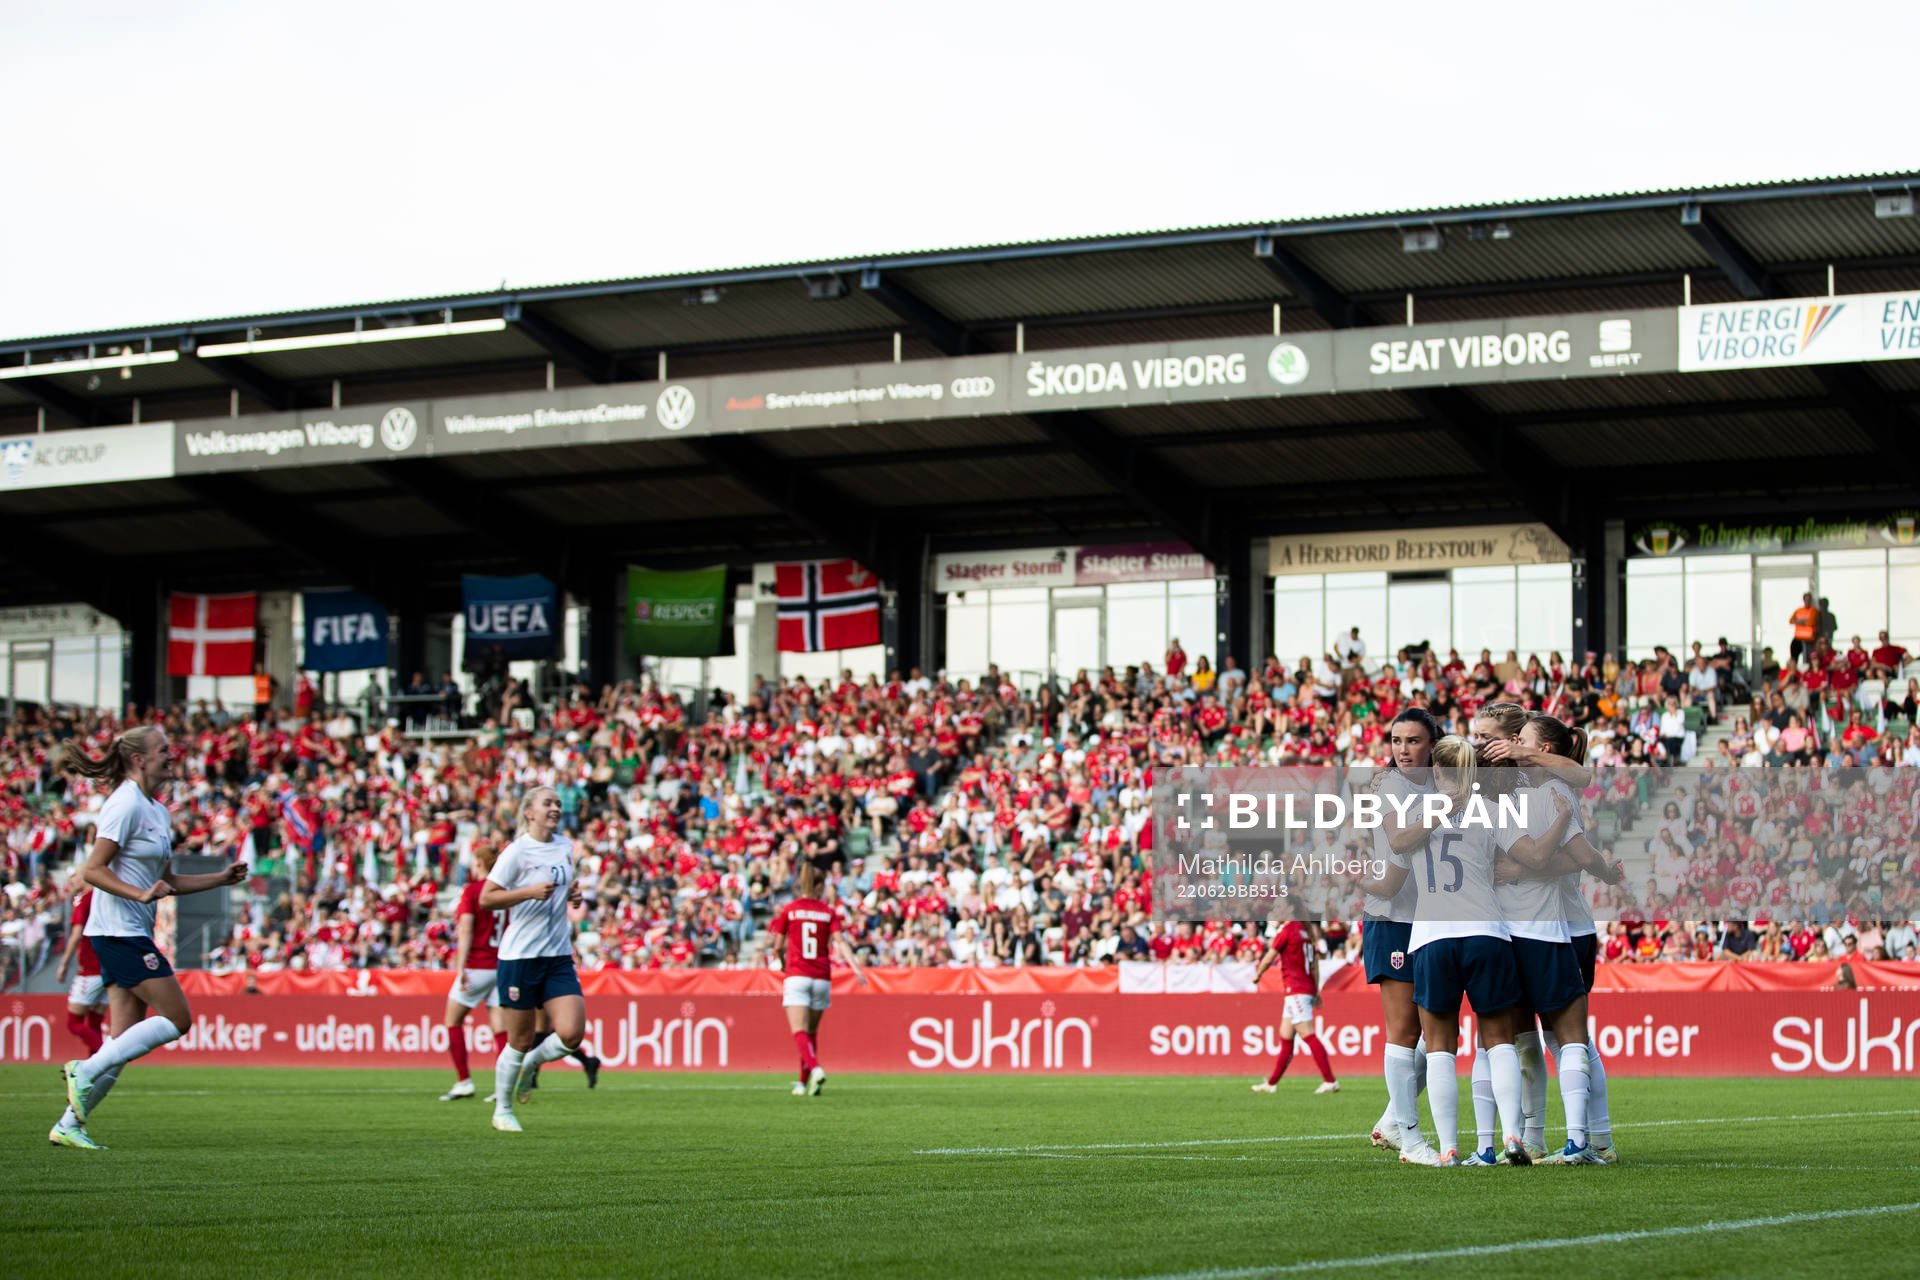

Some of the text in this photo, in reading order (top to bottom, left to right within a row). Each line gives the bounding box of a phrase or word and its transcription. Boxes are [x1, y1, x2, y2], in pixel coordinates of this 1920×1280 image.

[1699, 306, 1801, 335] ENERGI
[1369, 331, 1571, 374] SEAT VIBORG
[1589, 353, 1642, 368] SEAT
[1697, 334, 1795, 361] VIBORG
[1026, 353, 1247, 396] ŠKODA VIBORG
[887, 383, 943, 401] Viborg
[444, 411, 533, 434] Volkswagen
[186, 421, 374, 456] Volkswagen Viborg
[1083, 552, 1204, 574] Slagter Storm
[1280, 545, 1293, 566] A
[1299, 541, 1389, 564] HEREFORD
[945, 560, 1062, 581] Slagter Storm
[468, 603, 549, 633] UEFA
[652, 603, 716, 621] RESPECT
[312, 612, 380, 645] FIFA
[1425, 833, 1464, 893] 15
[802, 921, 817, 960] 6
[296, 1016, 371, 1053] uden
[383, 1015, 499, 1053] kaloie
[908, 1000, 1092, 1068] sukrin
[1150, 1025, 1231, 1056] som
